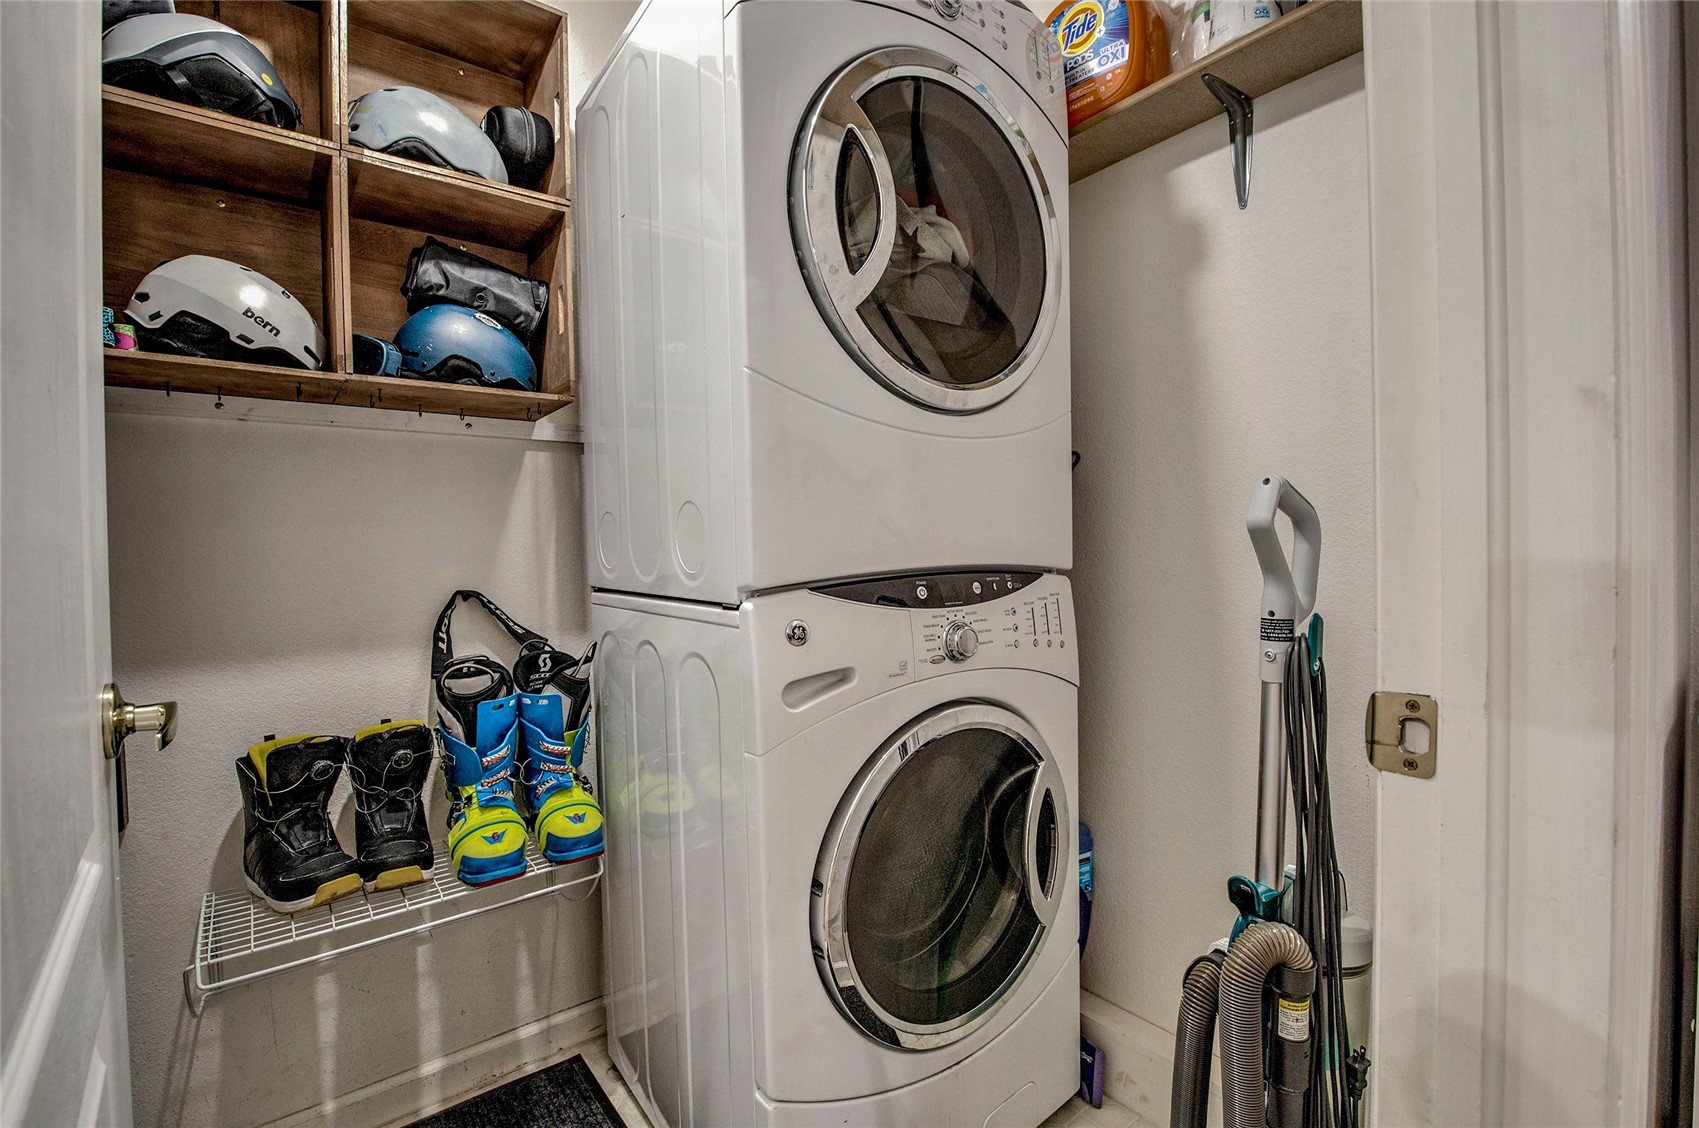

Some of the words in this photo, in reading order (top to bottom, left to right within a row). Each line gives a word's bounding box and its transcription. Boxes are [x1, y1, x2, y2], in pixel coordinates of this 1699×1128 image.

[1062, 11, 1098, 52] Tide
[1066, 49, 1094, 71] PODS
[1098, 46, 1125, 68] OXI
[1101, 41, 1124, 54] ULTRA
[242, 307, 281, 338] bern
[479, 595, 526, 634] SCOTT
